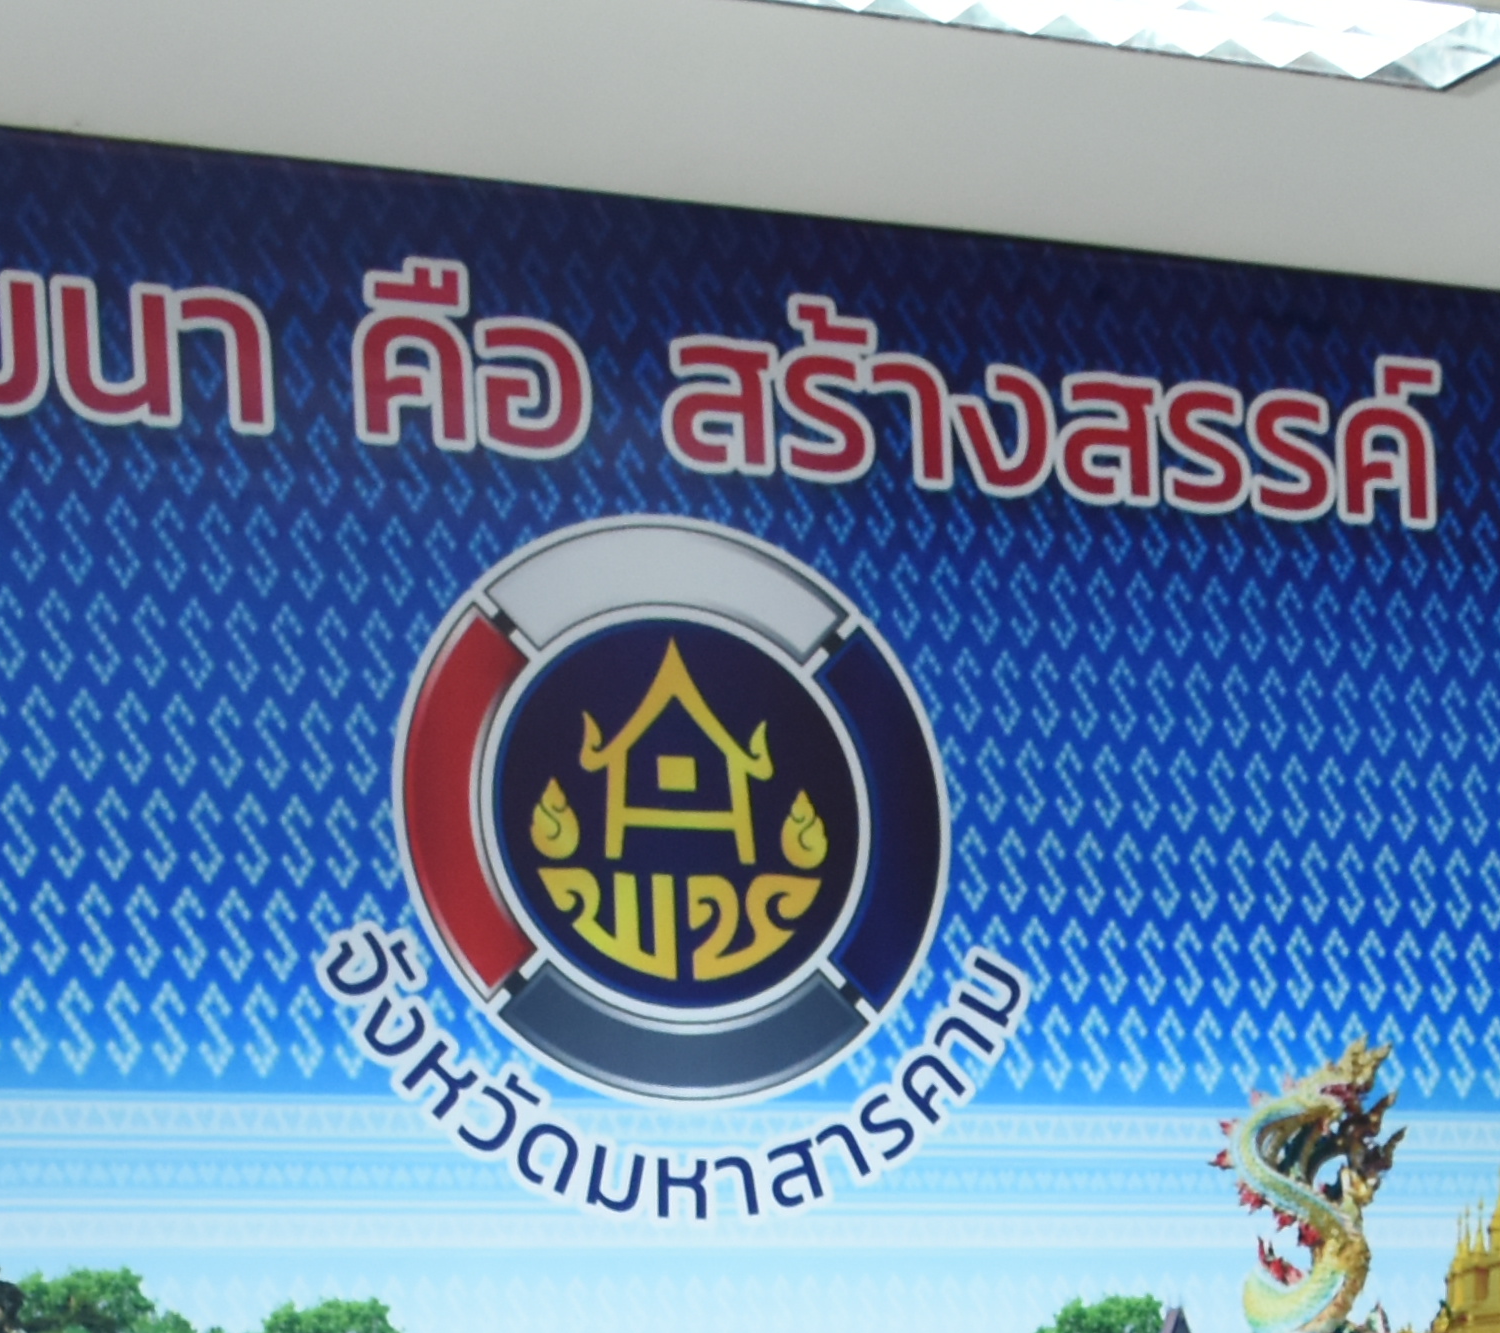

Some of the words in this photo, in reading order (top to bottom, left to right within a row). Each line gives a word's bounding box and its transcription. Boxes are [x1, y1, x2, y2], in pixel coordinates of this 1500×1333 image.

[352, 258, 592, 458] คือ
[663, 294, 1440, 528] สร้างสรรค์
[322, 922, 1028, 1222] จังหวัดมหาสารคาม
